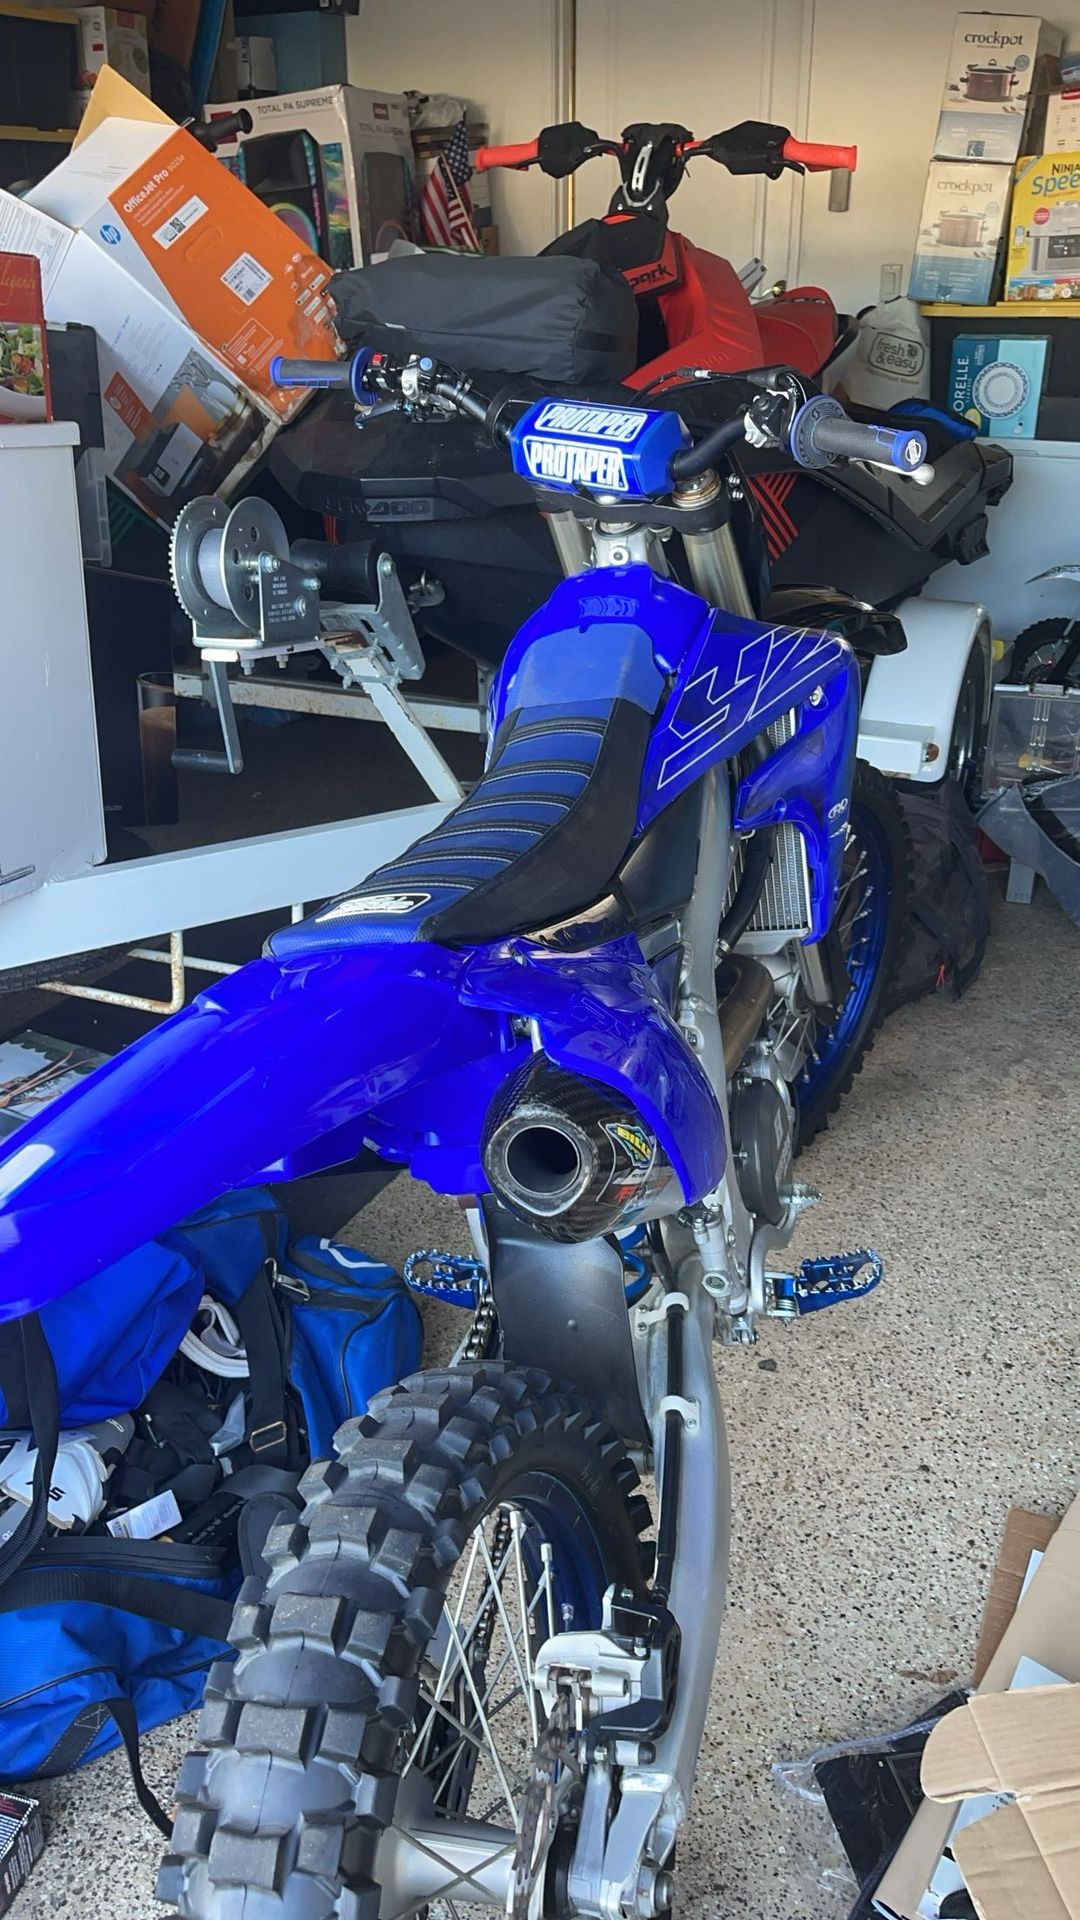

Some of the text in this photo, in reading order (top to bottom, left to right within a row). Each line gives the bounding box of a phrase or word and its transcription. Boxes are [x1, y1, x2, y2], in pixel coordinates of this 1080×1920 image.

[964, 31, 1023, 48] crockpot
[257, 104, 282, 114] TOTAL
[296, 96, 333, 109] SUPREME
[1051, 163, 1080, 175] NINJA
[123, 180, 157, 213] OfficeJet
[153, 169, 169, 185] Pro
[937, 180, 993, 195] crockpot
[629, 264, 674, 288] park
[953, 357, 969, 415] ORELLE
[541, 404, 641, 439] PROTAPER
[529, 442, 624, 488] PROTAPER
